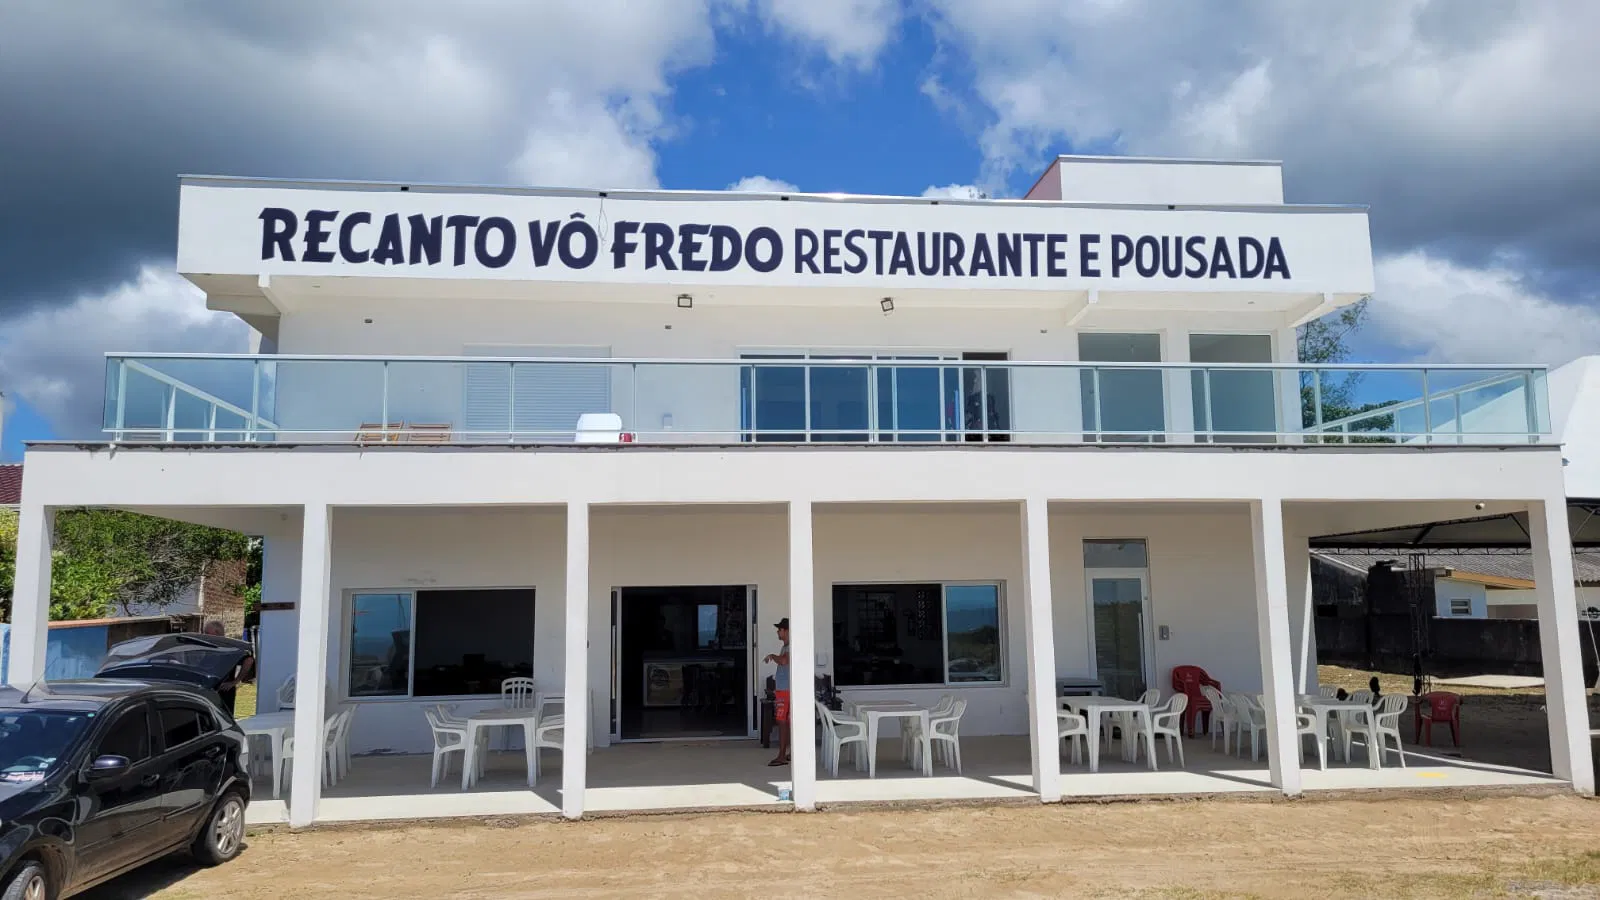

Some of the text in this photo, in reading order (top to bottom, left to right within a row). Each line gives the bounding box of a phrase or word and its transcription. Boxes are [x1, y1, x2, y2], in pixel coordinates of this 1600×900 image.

[258, 207, 1291, 279] RECANTO VÔ FREDO RESTAURANTE E POUSADA
